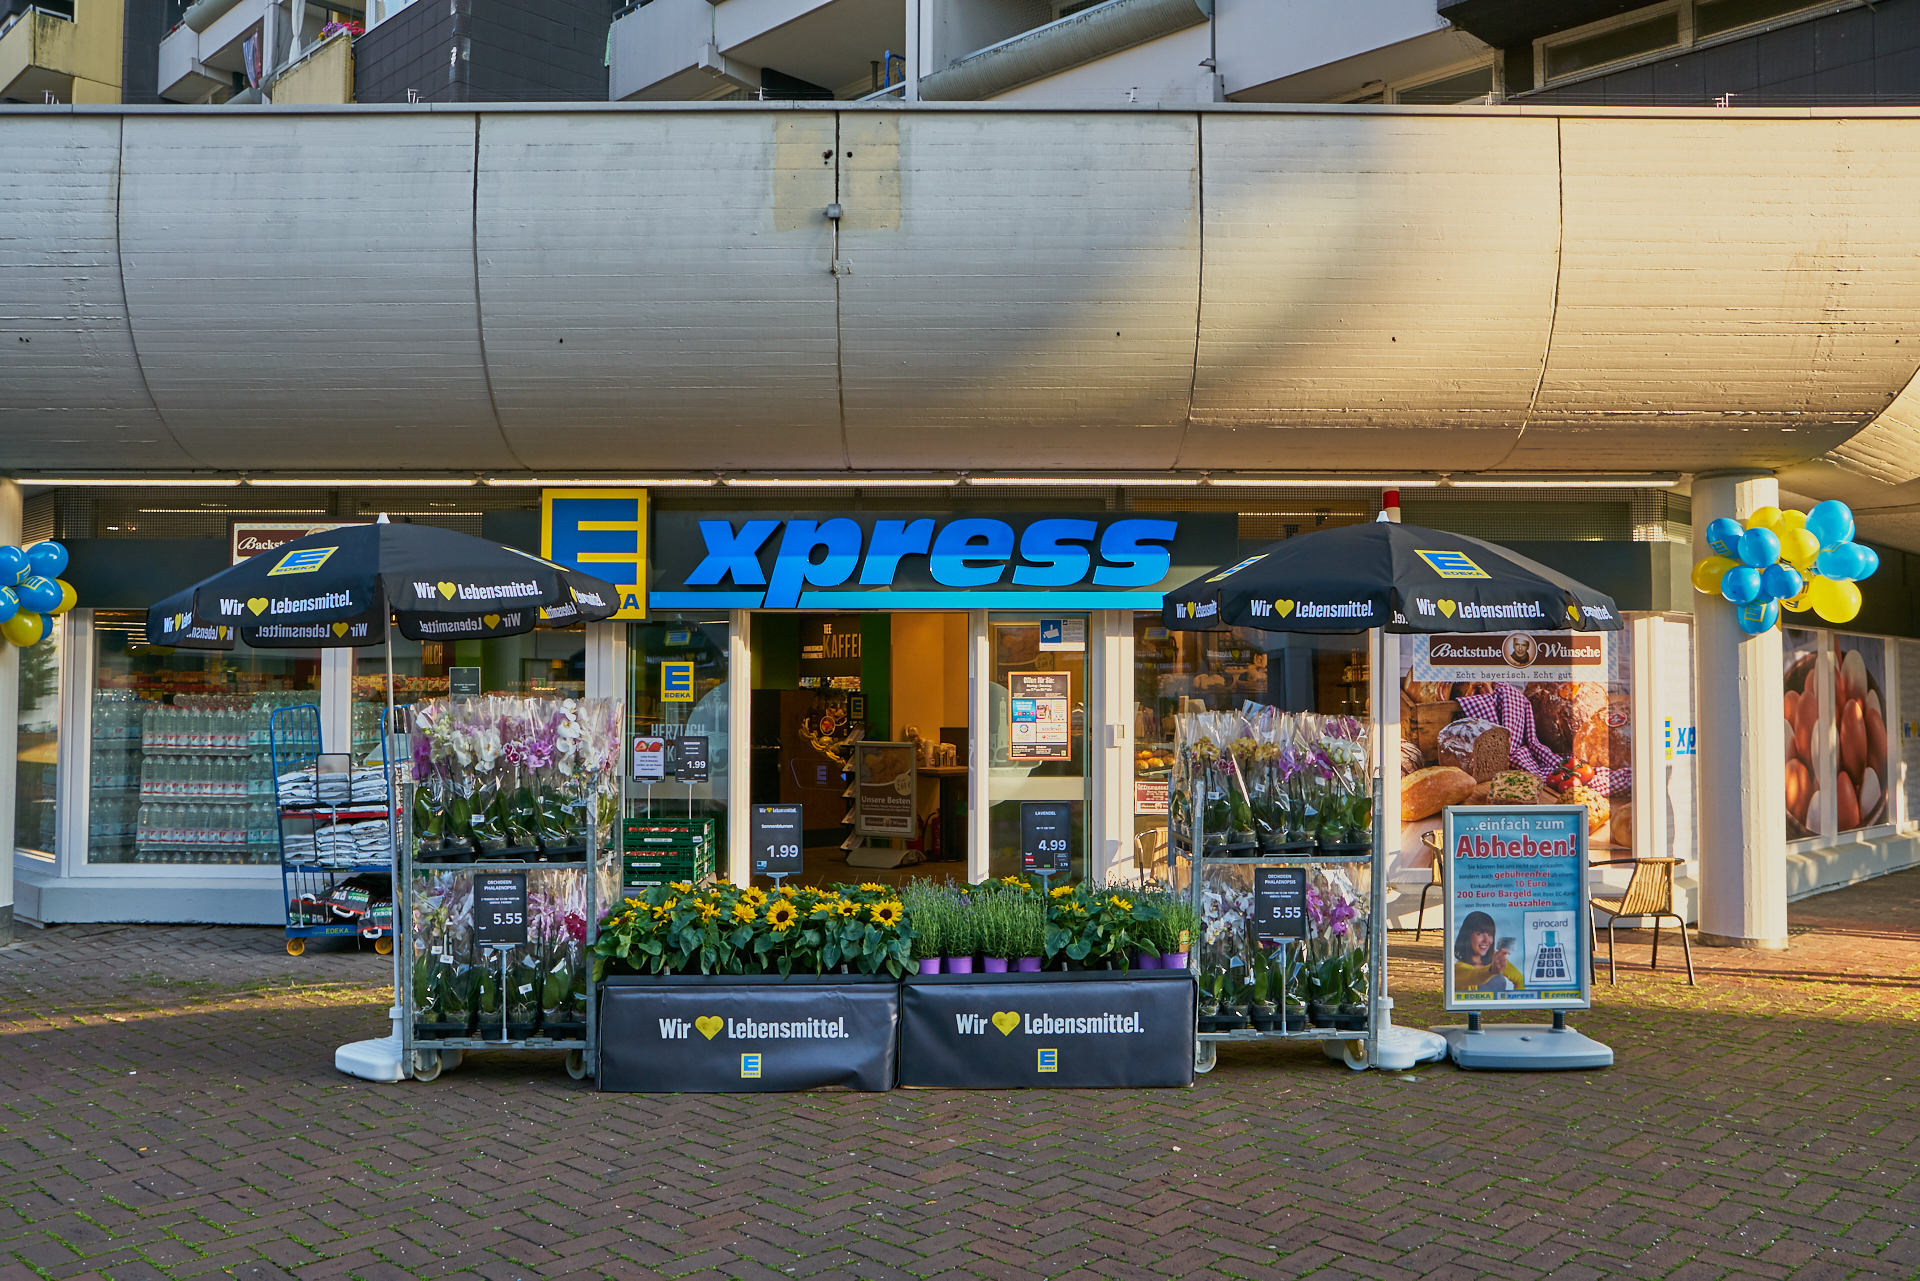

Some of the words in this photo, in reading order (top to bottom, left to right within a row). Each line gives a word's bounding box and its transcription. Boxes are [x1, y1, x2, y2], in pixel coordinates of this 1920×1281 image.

[275, 565, 316, 573] EDEKA
[684, 517, 1178, 608] xpress
[414, 582, 437, 599] Wir
[457, 580, 543, 600] Lebensmittel.
[220, 599, 244, 616] Wir
[270, 590, 353, 615] Lebensmittel.
[1251, 599, 1273, 617] Wir
[1295, 599, 1374, 618] Lebensmittel.
[1416, 597, 1436, 616] Wir
[1457, 601, 1546, 620] Lebensmittel.
[1176, 602, 1187, 619] Wir
[164, 617, 174, 633] Wir
[1430, 643, 1502, 659] Backstube
[1537, 641, 1601, 659] Wünsche
[665, 665, 690, 691] E
[1456, 671, 1476, 679] Echt
[1481, 671, 1529, 680] bayerisch.
[1534, 671, 1553, 679] Echt
[687, 761, 706, 769] 1.99
[861, 796, 886, 804] Unsere
[887, 796, 911, 805] Besten
[1465, 817, 1530, 831] ...einfach
[1535, 820, 1564, 830] zum
[767, 844, 799, 858] 1.99
[1038, 839, 1067, 851] 4.99
[1456, 833, 1576, 858] Abheben!
[1494, 870, 1550, 880] gebührenfrei
[1515, 880, 1525, 888] 10
[1527, 880, 1547, 888] Euro
[1457, 891, 1474, 899] 200
[1476, 890, 1495, 898] Euro
[1498, 889, 1532, 899] Bargeld
[493, 912, 522, 925] 5.55
[1273, 907, 1301, 919] 5.55
[1532, 919, 1569, 930] girocard
[659, 1018, 691, 1039] Wir
[728, 1016, 849, 1039] Lebensmittel.
[956, 1013, 987, 1034] Wir
[1024, 1011, 1144, 1034] Lebensmittel.
